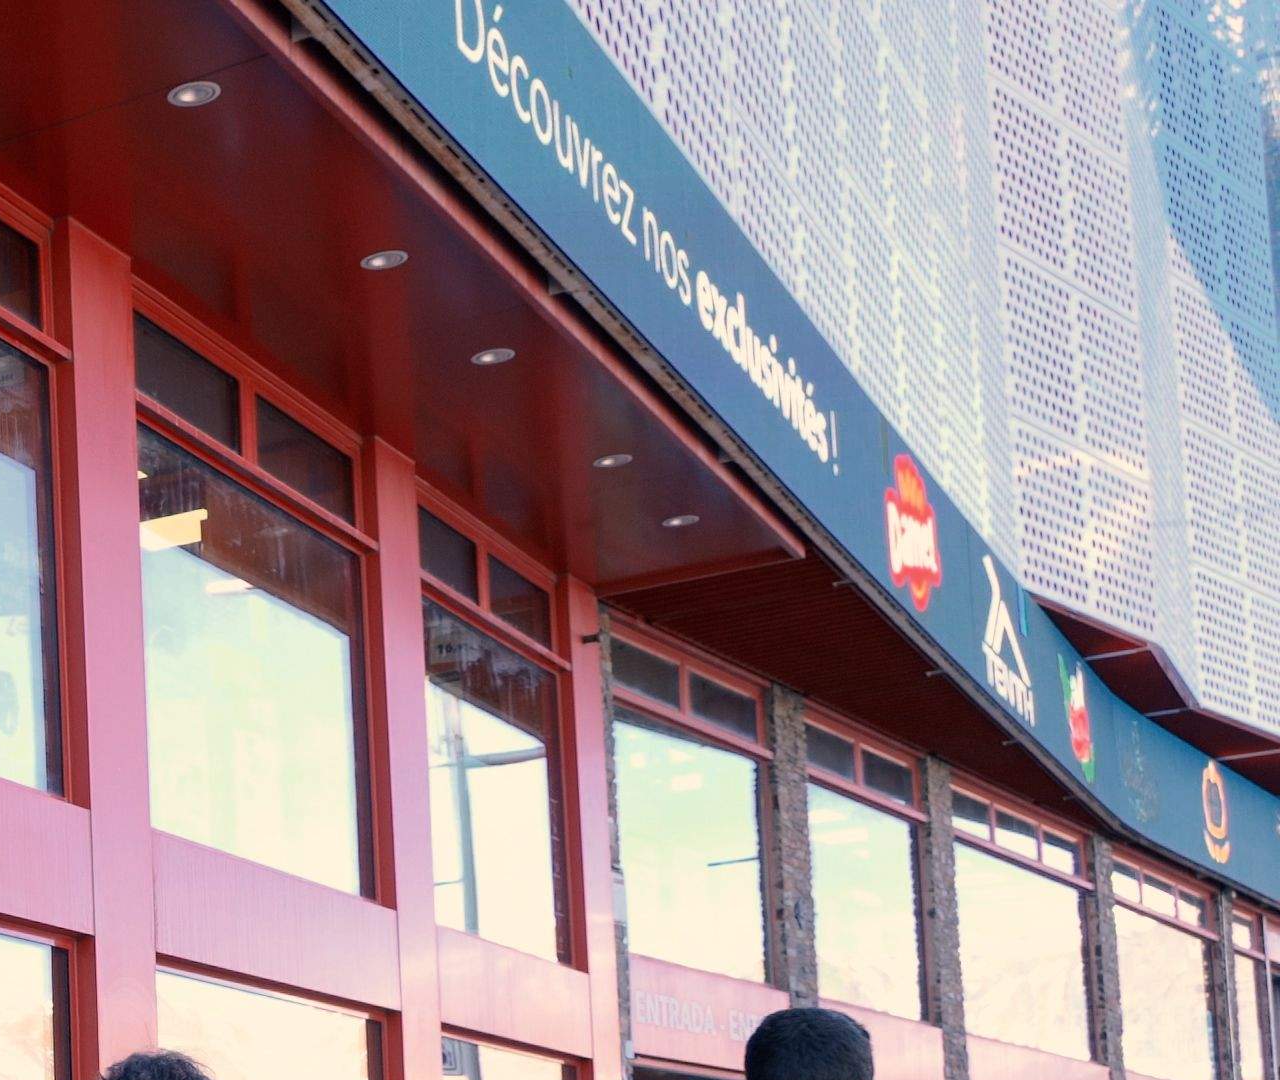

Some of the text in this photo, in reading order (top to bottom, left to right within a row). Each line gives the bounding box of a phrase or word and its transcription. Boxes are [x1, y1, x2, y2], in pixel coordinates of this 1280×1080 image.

[455, 0, 637, 246] Découvrez
[643, 207, 692, 306] nos
[696, 271, 829, 463] exclusivités
